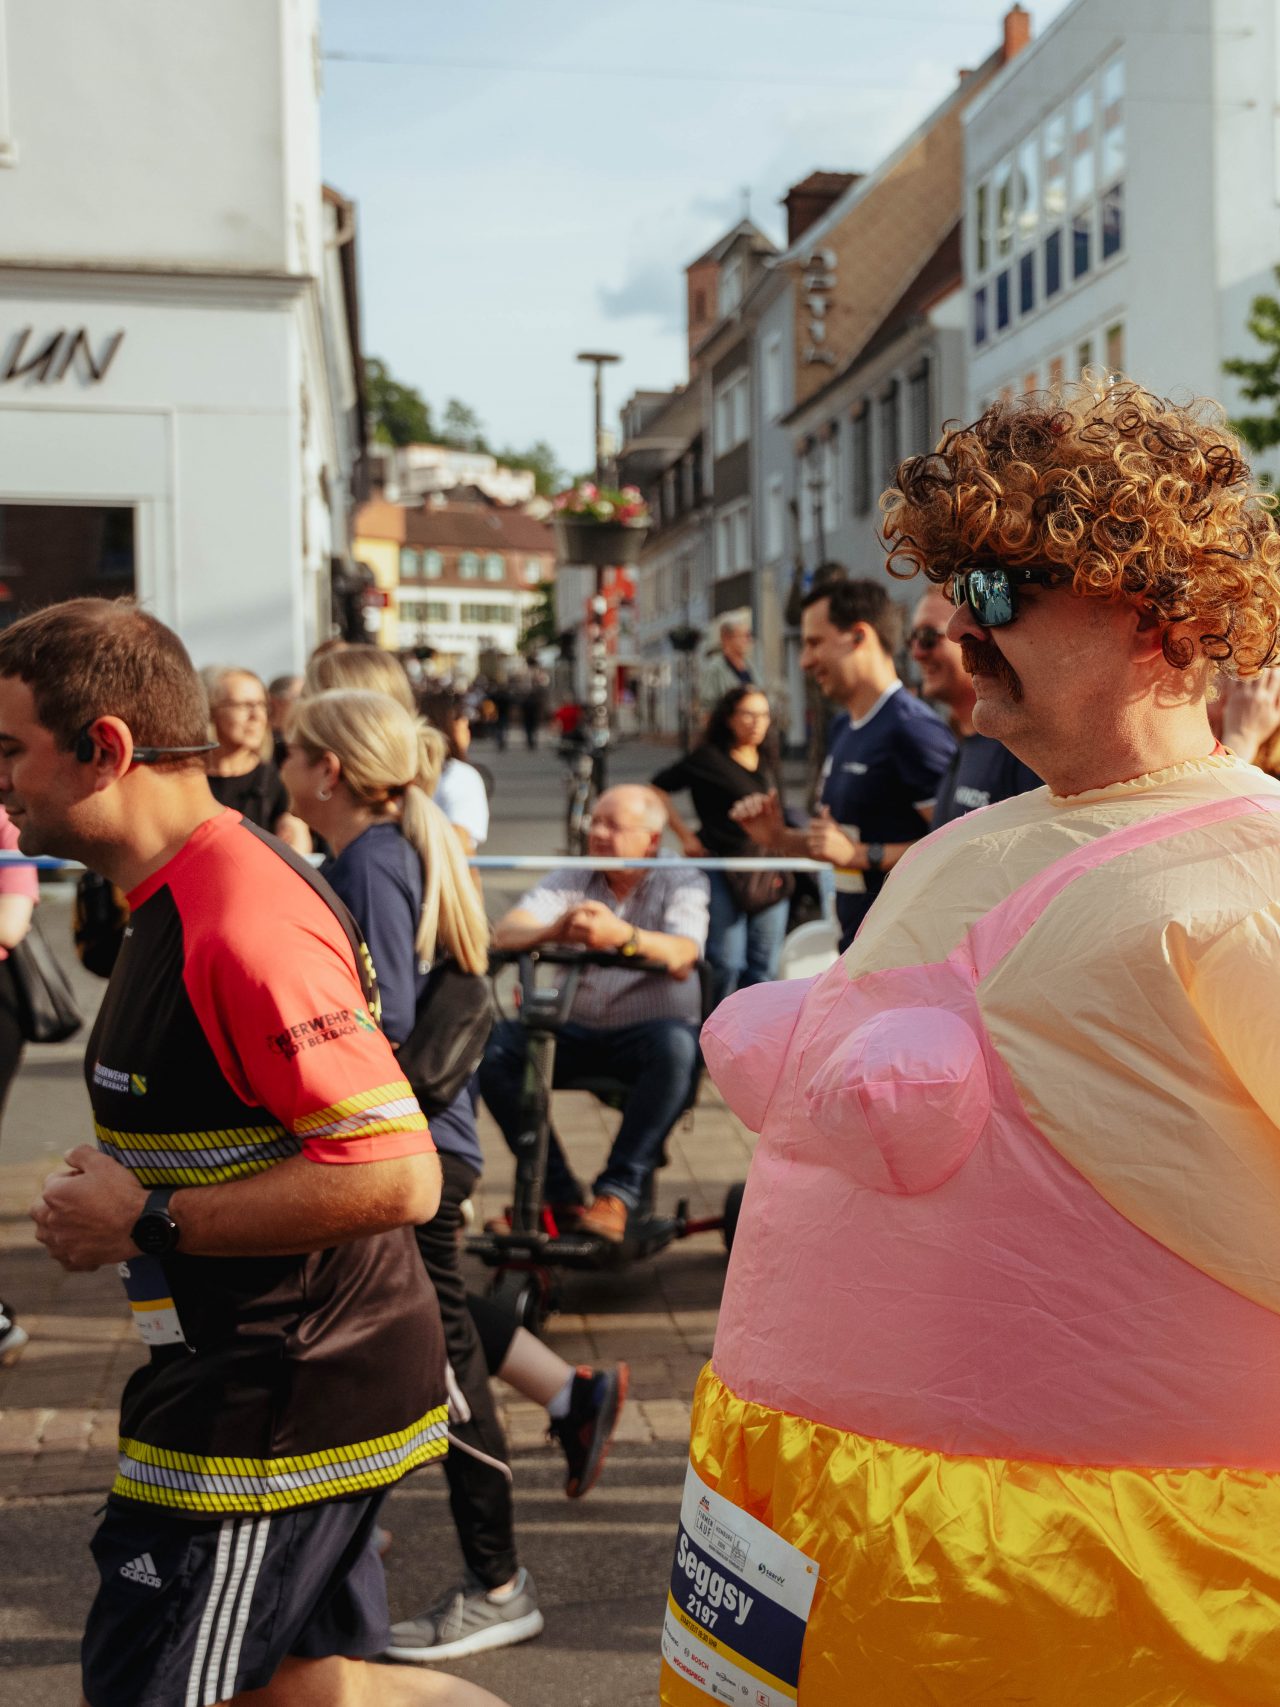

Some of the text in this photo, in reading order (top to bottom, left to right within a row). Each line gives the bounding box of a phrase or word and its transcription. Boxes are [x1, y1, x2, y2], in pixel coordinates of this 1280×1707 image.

[696, 1517, 712, 1537] LAUF
[120, 1566, 162, 1589] adidas
[677, 1532, 754, 1626] Seggsy
[686, 1593, 719, 1629] 2197
[691, 1653, 710, 1671] BOSCH
